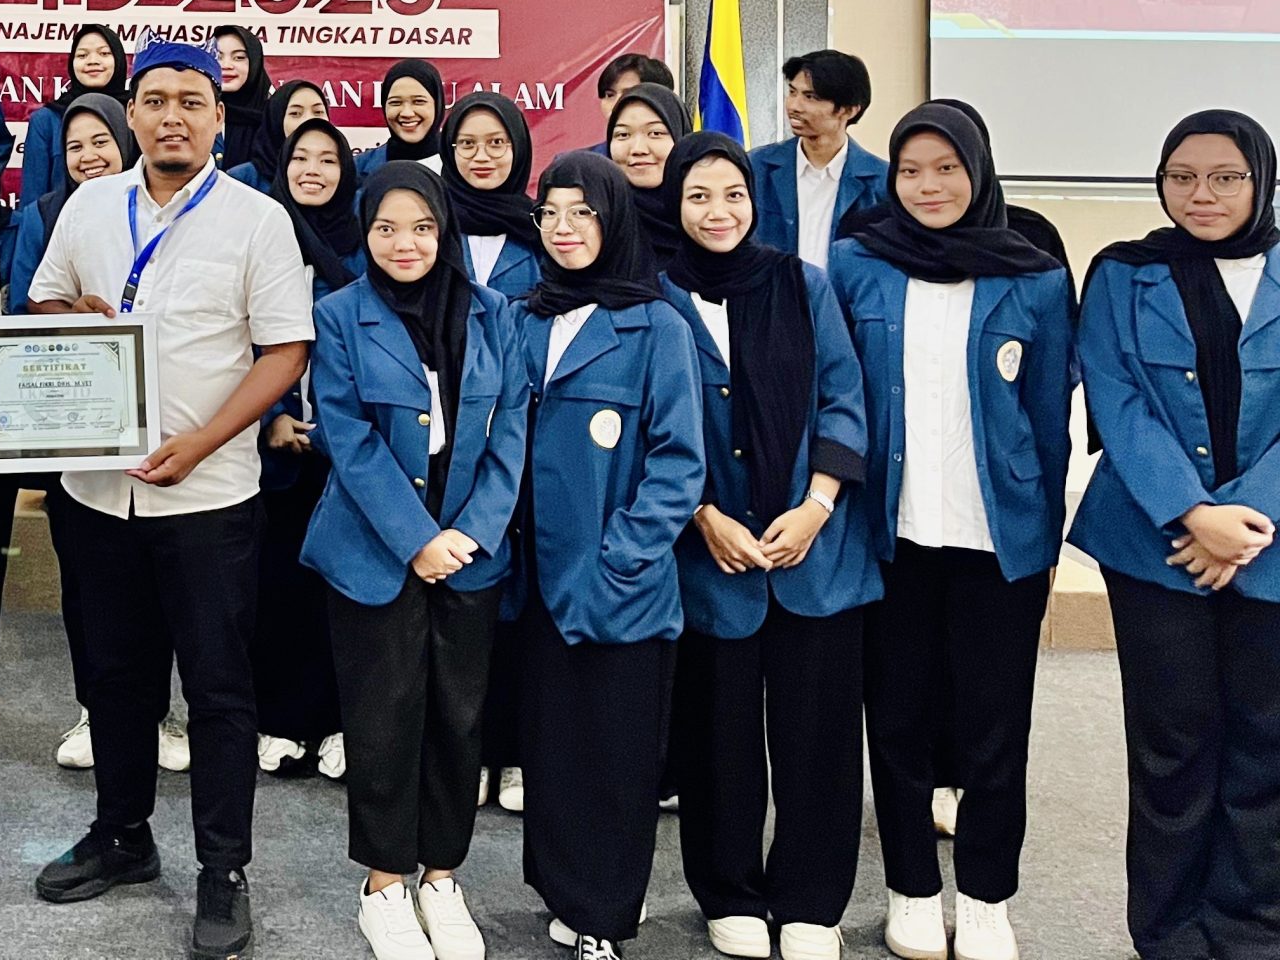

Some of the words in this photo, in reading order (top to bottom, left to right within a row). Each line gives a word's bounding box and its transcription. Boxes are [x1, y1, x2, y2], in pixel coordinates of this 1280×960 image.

[277, 26, 384, 44] TINGKAT
[388, 27, 473, 45] DASAR
[322, 80, 362, 108] AN
